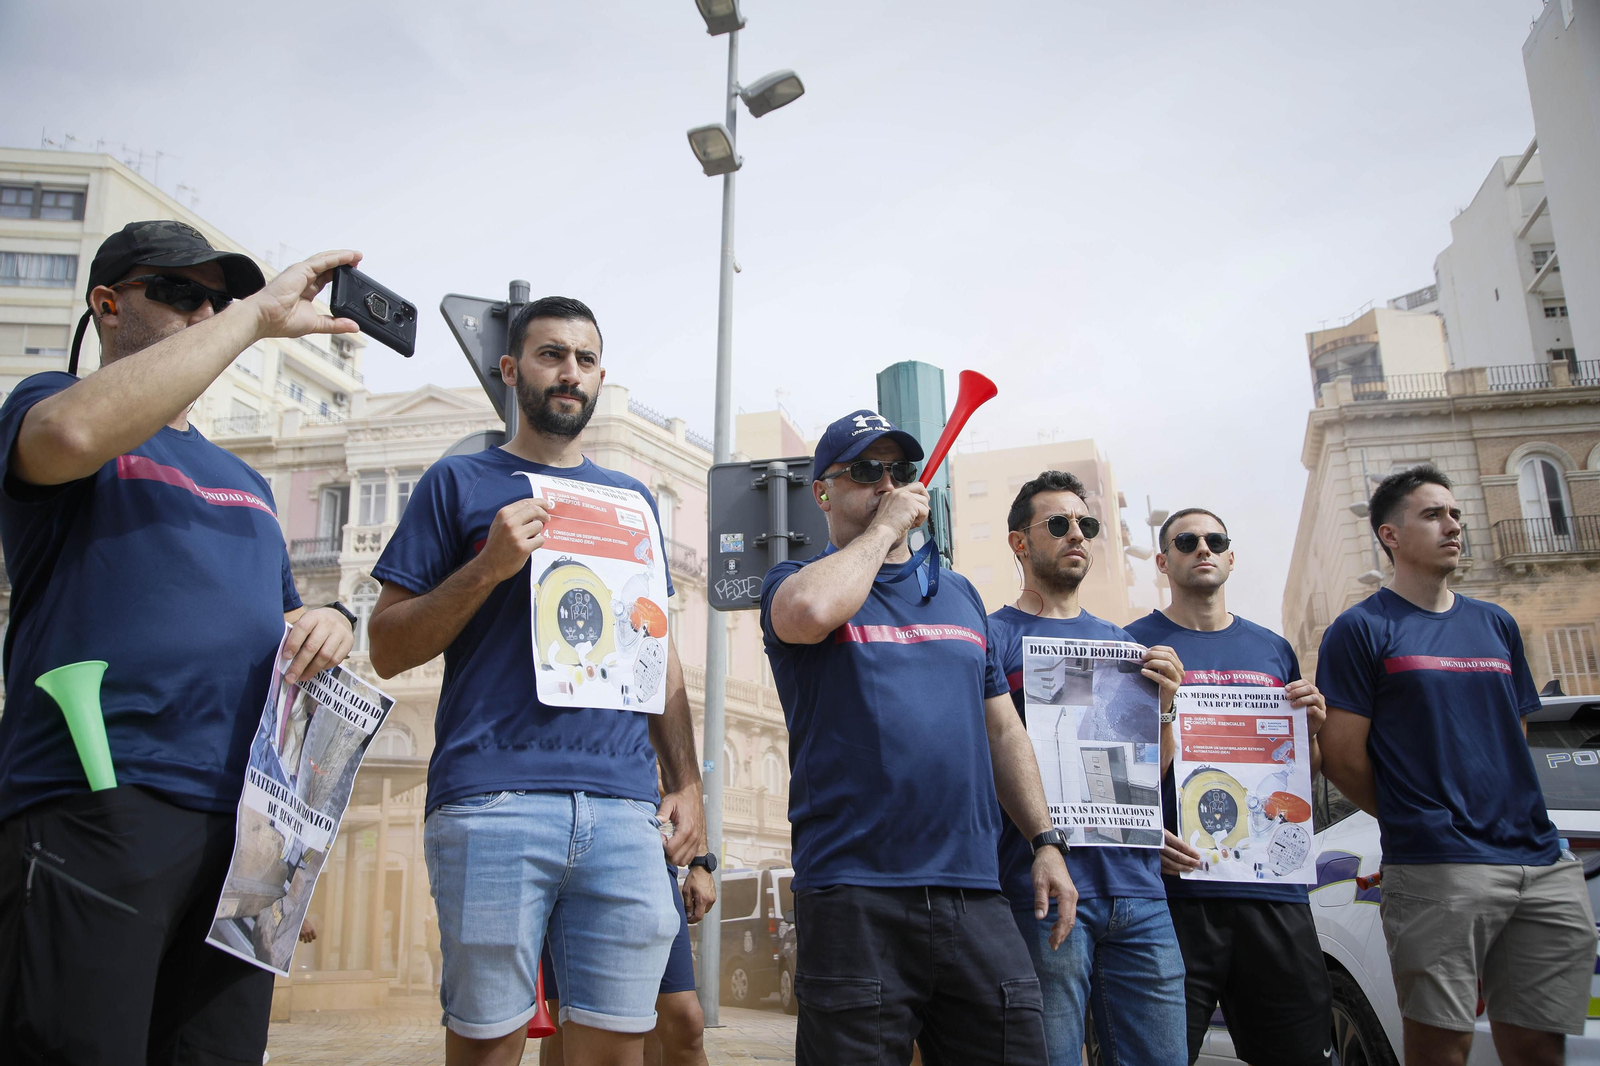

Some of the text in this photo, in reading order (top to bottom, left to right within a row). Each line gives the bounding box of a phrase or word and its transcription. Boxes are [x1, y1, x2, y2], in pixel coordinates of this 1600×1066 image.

[851, 426, 873, 437] UNDER
[547, 495, 556, 510] 5
[895, 628, 942, 640] DIGNIDAD
[1029, 644, 1144, 660] DIGNIDAD BOMBERO
[1440, 660, 1478, 668] DIGNIDAD
[1193, 672, 1274, 686] DIGNIDAD BOMBEROS
[333, 682, 345, 697] LA
[343, 690, 382, 720] CALIDAD
[1244, 693, 1271, 701] PODER
[1197, 700, 1213, 708] UNA
[1244, 701, 1280, 709] CALIDAD
[331, 701, 368, 729] MENGUA
[1183, 720, 1192, 731] 5
[1546, 750, 1600, 768] PO
[248, 769, 289, 804] MATERIAL
[267, 800, 279, 818] DE
[1047, 806, 1155, 817] OR UNAS INSTALACIONES
[1050, 816, 1070, 826] QUE
[1072, 816, 1086, 825] NO
[1088, 816, 1107, 826] DEN
